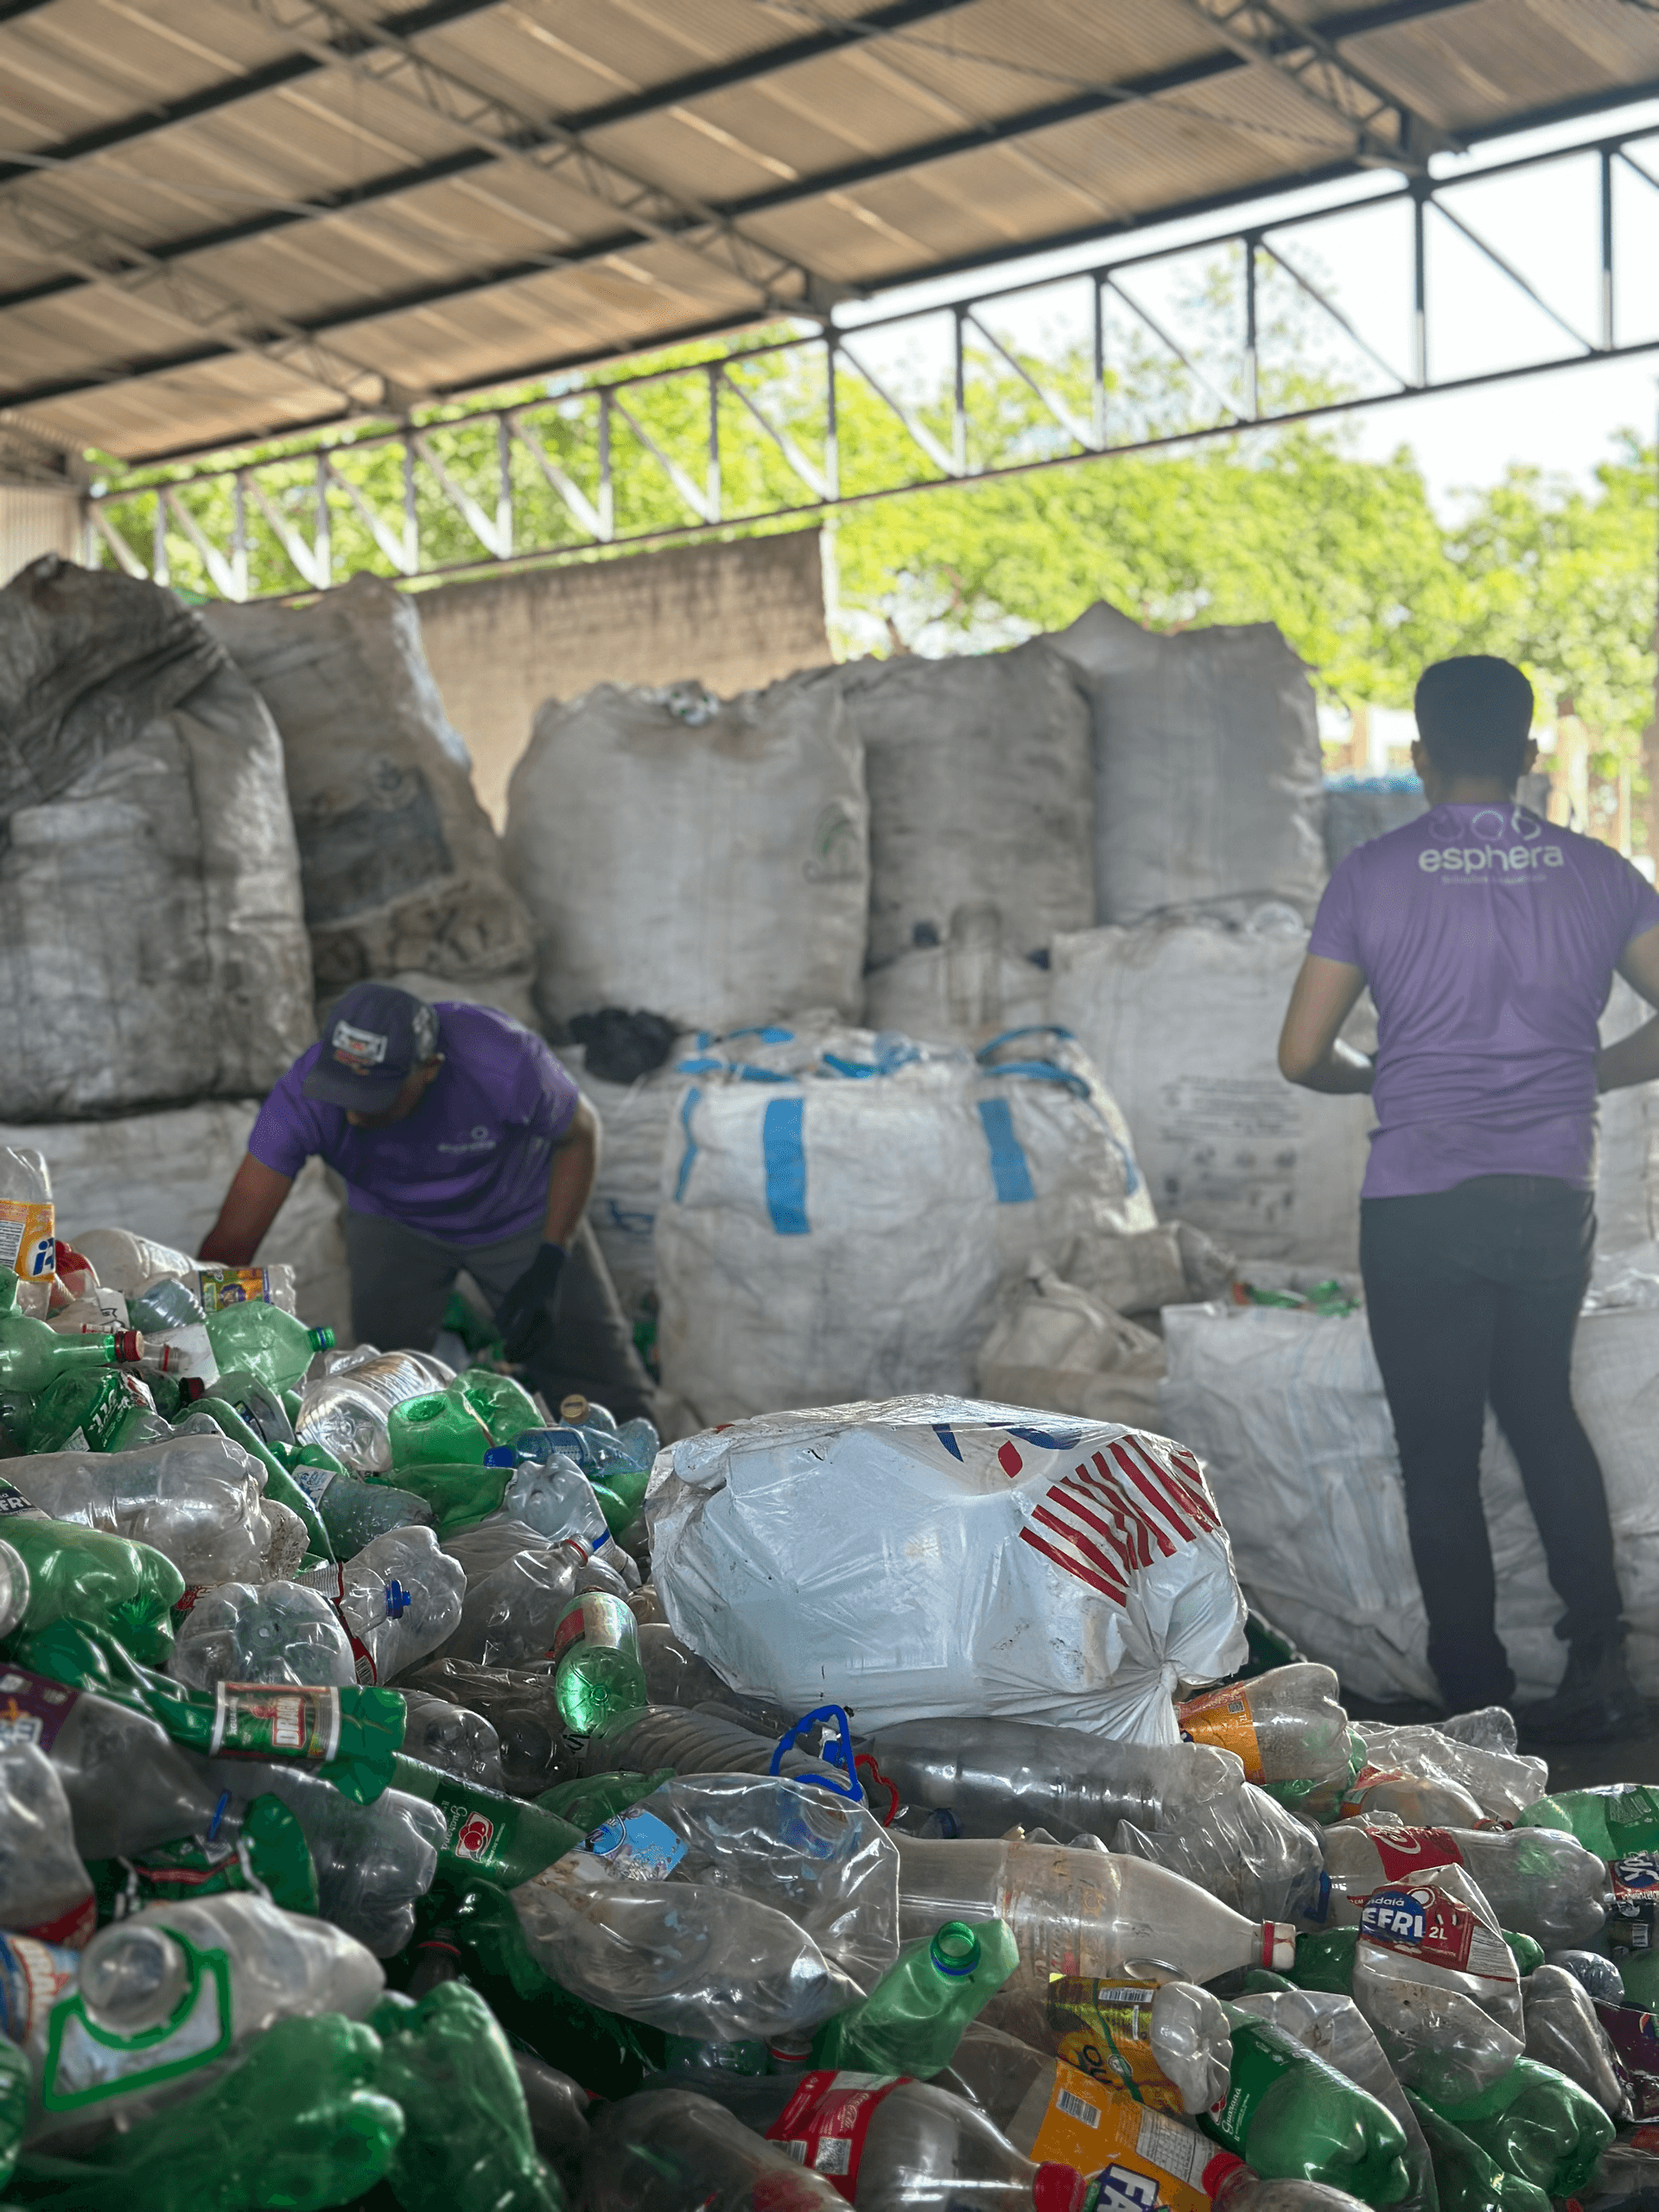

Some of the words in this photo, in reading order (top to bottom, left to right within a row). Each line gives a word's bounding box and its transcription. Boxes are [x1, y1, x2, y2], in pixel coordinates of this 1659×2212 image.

[1419, 844, 1564, 874] esphera
[1368, 1897, 1405, 1907] ndaiá
[1362, 1906, 1426, 1938] EFRI
[1428, 1926, 1448, 1941] 2L
